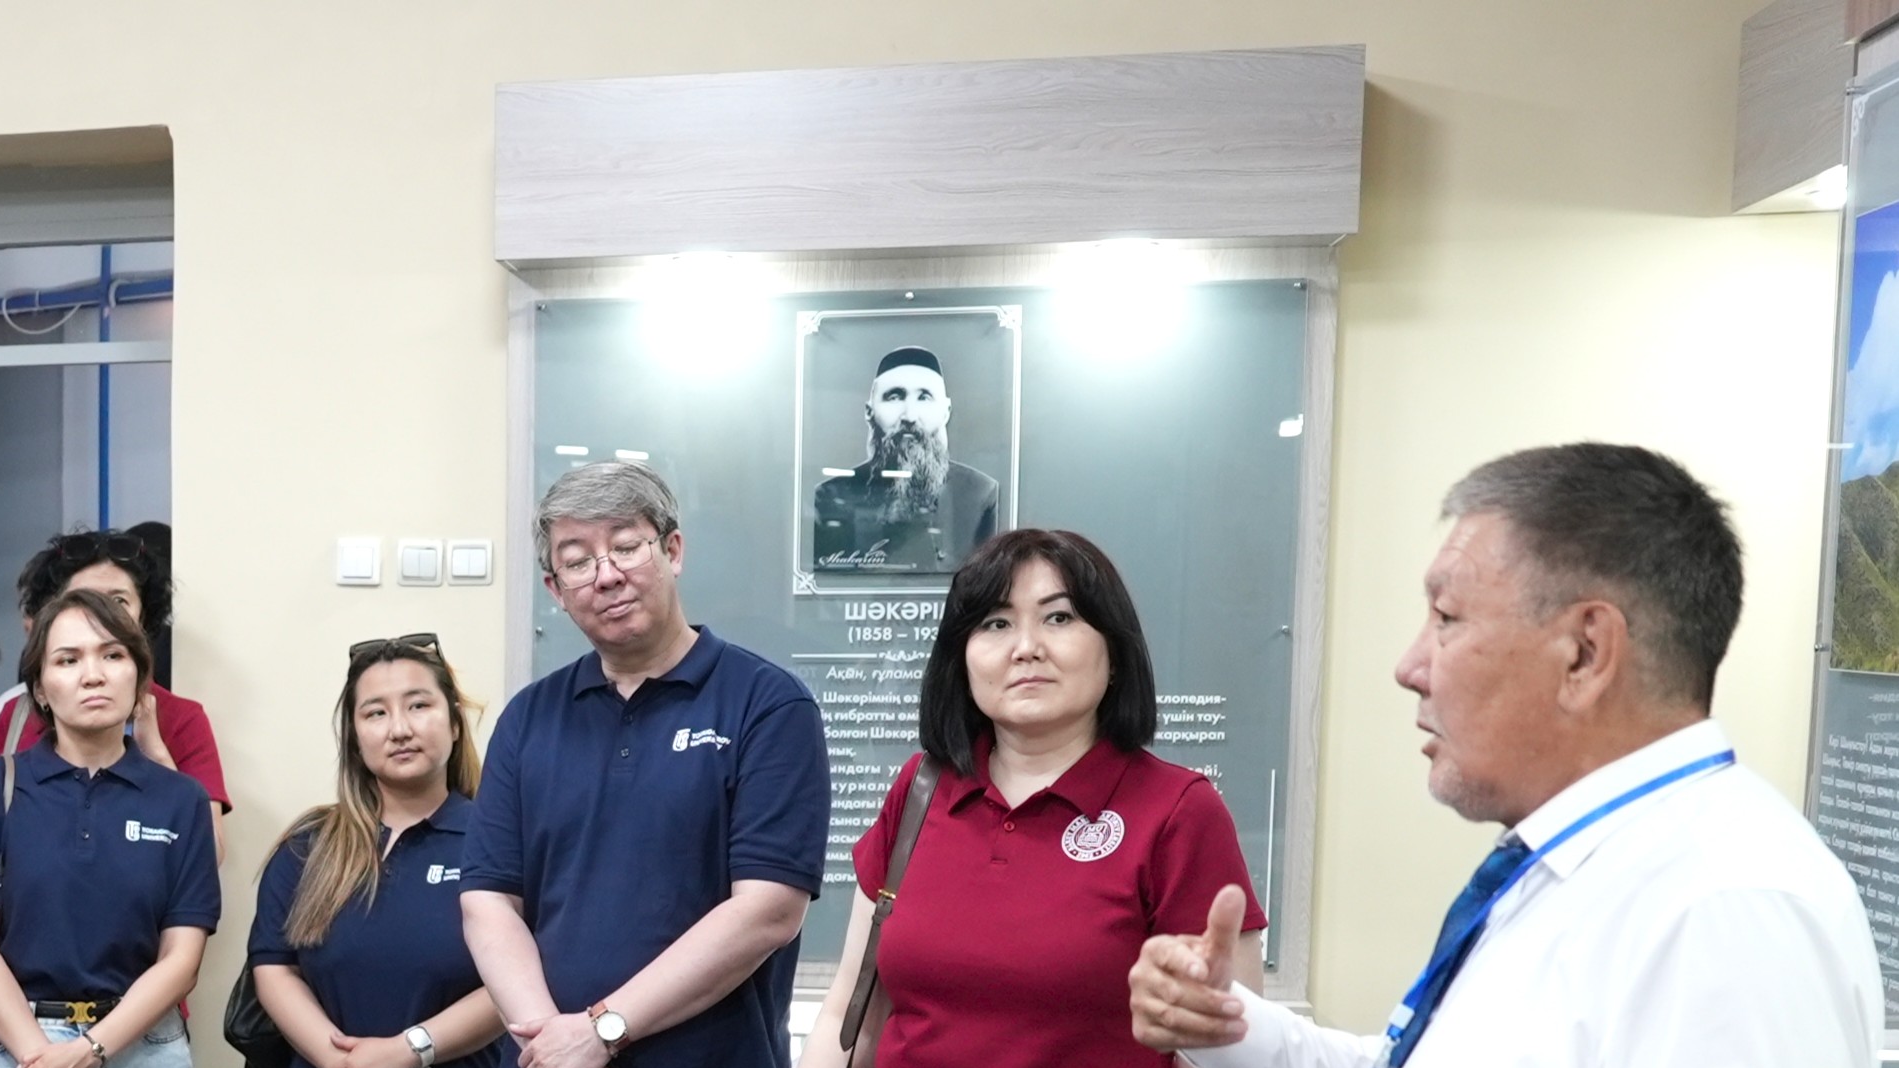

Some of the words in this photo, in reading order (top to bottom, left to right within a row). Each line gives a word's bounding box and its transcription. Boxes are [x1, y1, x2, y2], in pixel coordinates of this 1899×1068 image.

[848, 626, 893, 643] (1858
[914, 626, 938, 641] 193
[823, 692, 901, 706] Шәкәрімнің
[1156, 695, 1227, 706] клопедия-
[834, 709, 895, 723] ғибратты
[898, 710, 919, 721] өмі
[1163, 710, 1194, 724] үшін
[1197, 714, 1226, 724] тау-
[870, 726, 919, 741] Шәкәрі
[831, 765, 881, 775] ындағы
[831, 800, 876, 810] ындағы
[830, 817, 861, 826] сына
